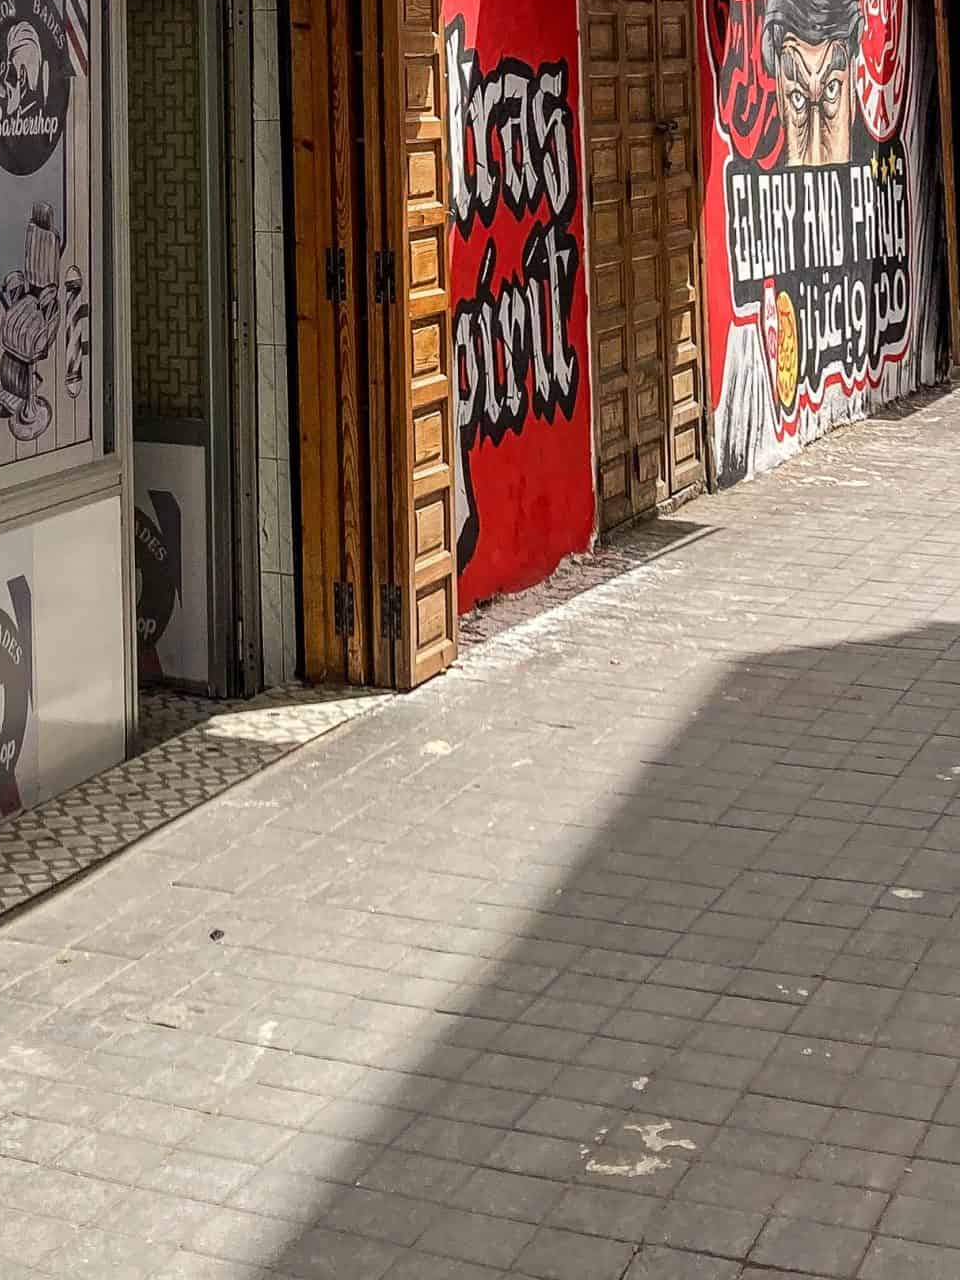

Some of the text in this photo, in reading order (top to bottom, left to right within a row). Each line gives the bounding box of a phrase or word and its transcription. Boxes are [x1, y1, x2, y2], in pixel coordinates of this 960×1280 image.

[444, 20, 573, 230] tras
[732, 173, 795, 281] GLORY
[803, 170, 844, 268] AND
[454, 223, 577, 546] pirit
[136, 523, 168, 561] DES
